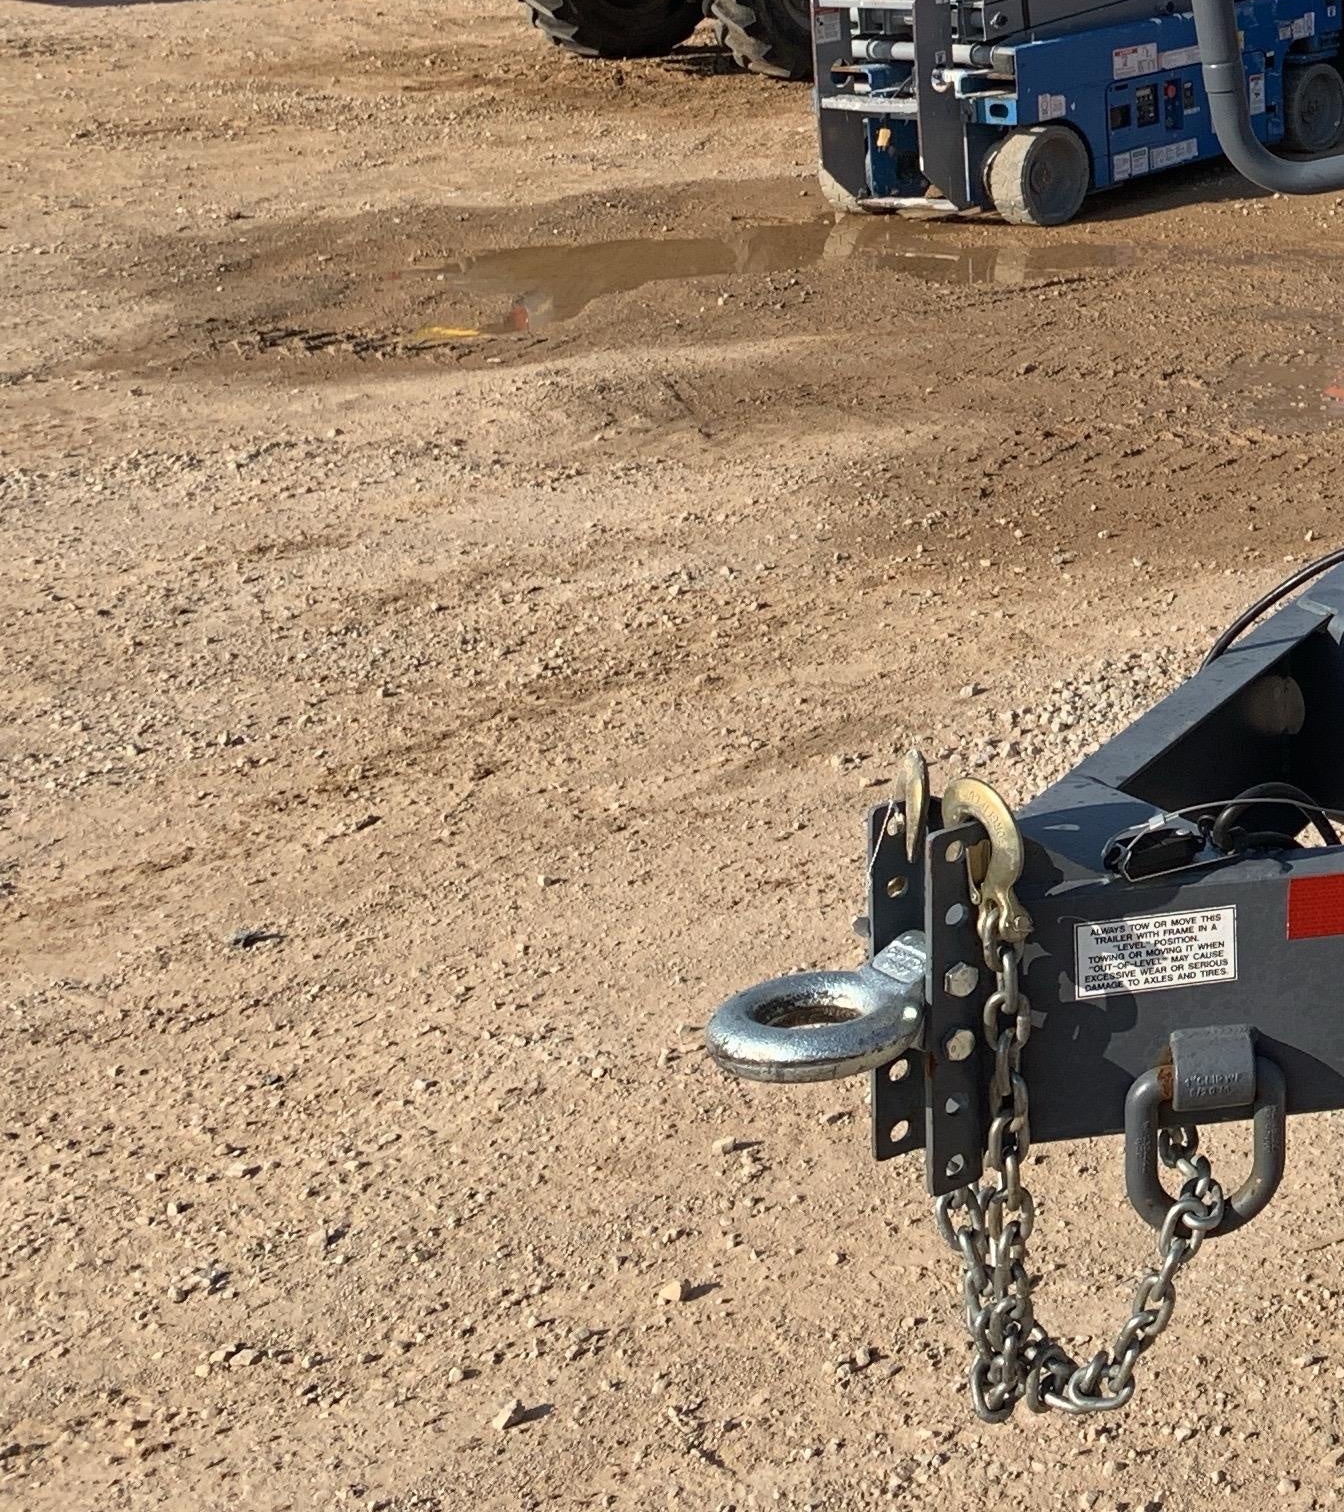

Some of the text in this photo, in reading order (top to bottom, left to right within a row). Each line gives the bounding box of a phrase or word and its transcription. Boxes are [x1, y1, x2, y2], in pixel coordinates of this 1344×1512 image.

[1090, 914, 1221, 936] ALWAYS TOW OR MOVE THIS
[1094, 933, 1132, 945] TRAILER
[1136, 930, 1159, 939] WITH
[1163, 927, 1194, 936] FRAME
[1154, 936, 1199, 946] POSITION.
[1089, 953, 1124, 964] TOWING
[1146, 947, 1182, 956] MOVING
[1198, 941, 1225, 950] WHEN
[1171, 954, 1188, 962] MAY
[1193, 950, 1224, 960] CAUSE
[1085, 970, 1136, 983] EXCESSIVE
[1140, 967, 1167, 976] WEAR
[1188, 959, 1228, 970] SERIOUS
[1085, 981, 1123, 991] DAMAGE
[1128, 978, 1140, 986] TO
[1144, 975, 1173, 984] AXLES
[1178, 972, 1196, 980] AND
